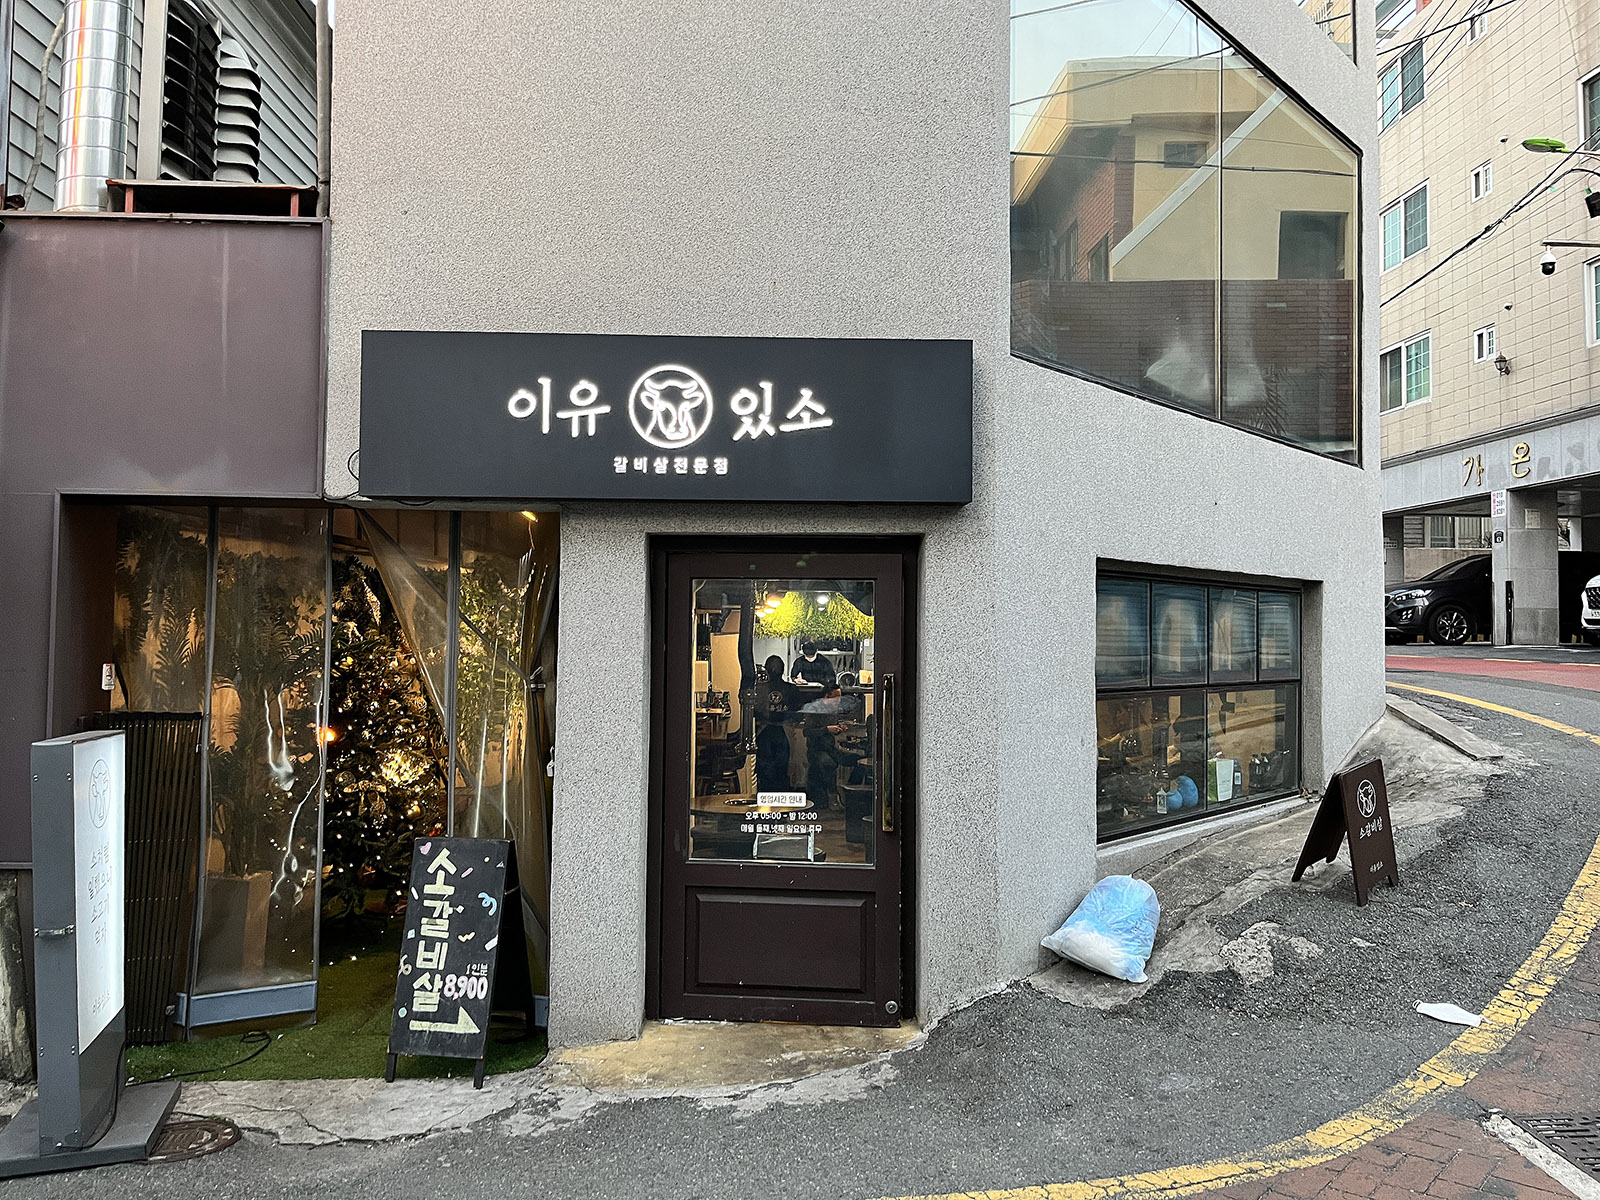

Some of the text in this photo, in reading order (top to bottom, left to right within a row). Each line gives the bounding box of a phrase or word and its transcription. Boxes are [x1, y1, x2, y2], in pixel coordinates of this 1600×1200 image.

[507, 377, 834, 442] 이유 있소
[613, 456, 729, 475] 갈비살전문점
[745, 811, 759, 820] 오후
[760, 812, 782, 820] 05:00
[789, 812, 797, 821] 밤
[798, 812, 818, 820] 12:00
[740, 824, 754, 833] 매월
[412, 847, 457, 1012] 소갈비살
[465, 963, 489, 976] 1인분
[443, 973, 489, 1001] 8,900
